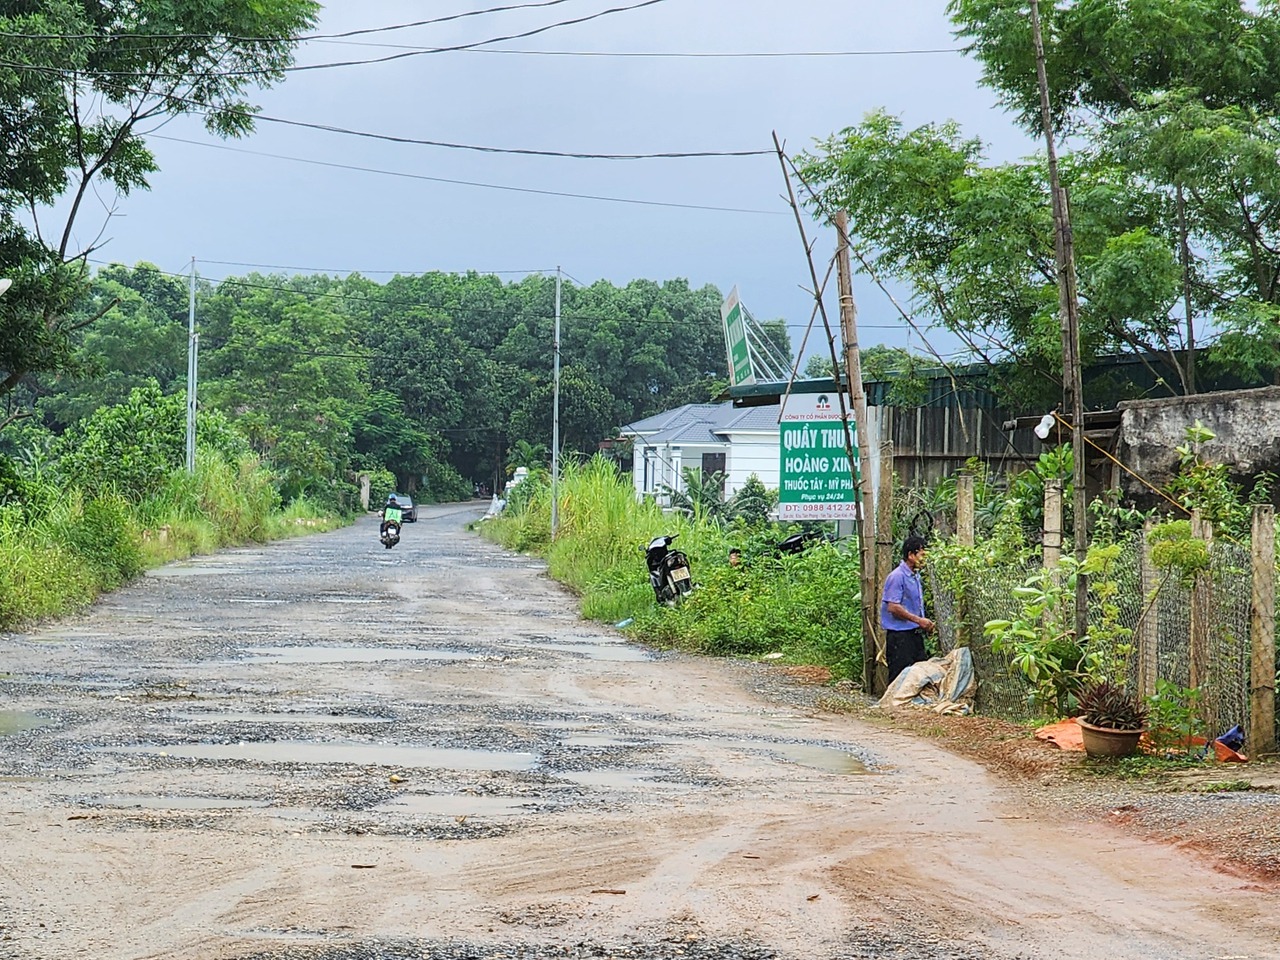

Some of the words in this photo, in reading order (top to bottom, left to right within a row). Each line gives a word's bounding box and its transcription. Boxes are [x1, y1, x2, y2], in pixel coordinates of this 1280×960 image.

[784, 423, 818, 451] QUẦY
[785, 453, 829, 473] HOÀNG
[784, 475, 809, 490] THUỐC
[810, 476, 824, 490] TÂY
[828, 476, 839, 490] MỸ
[825, 493, 845, 501] 24/24
[802, 504, 824, 512] 0988
[826, 504, 843, 512] 412
